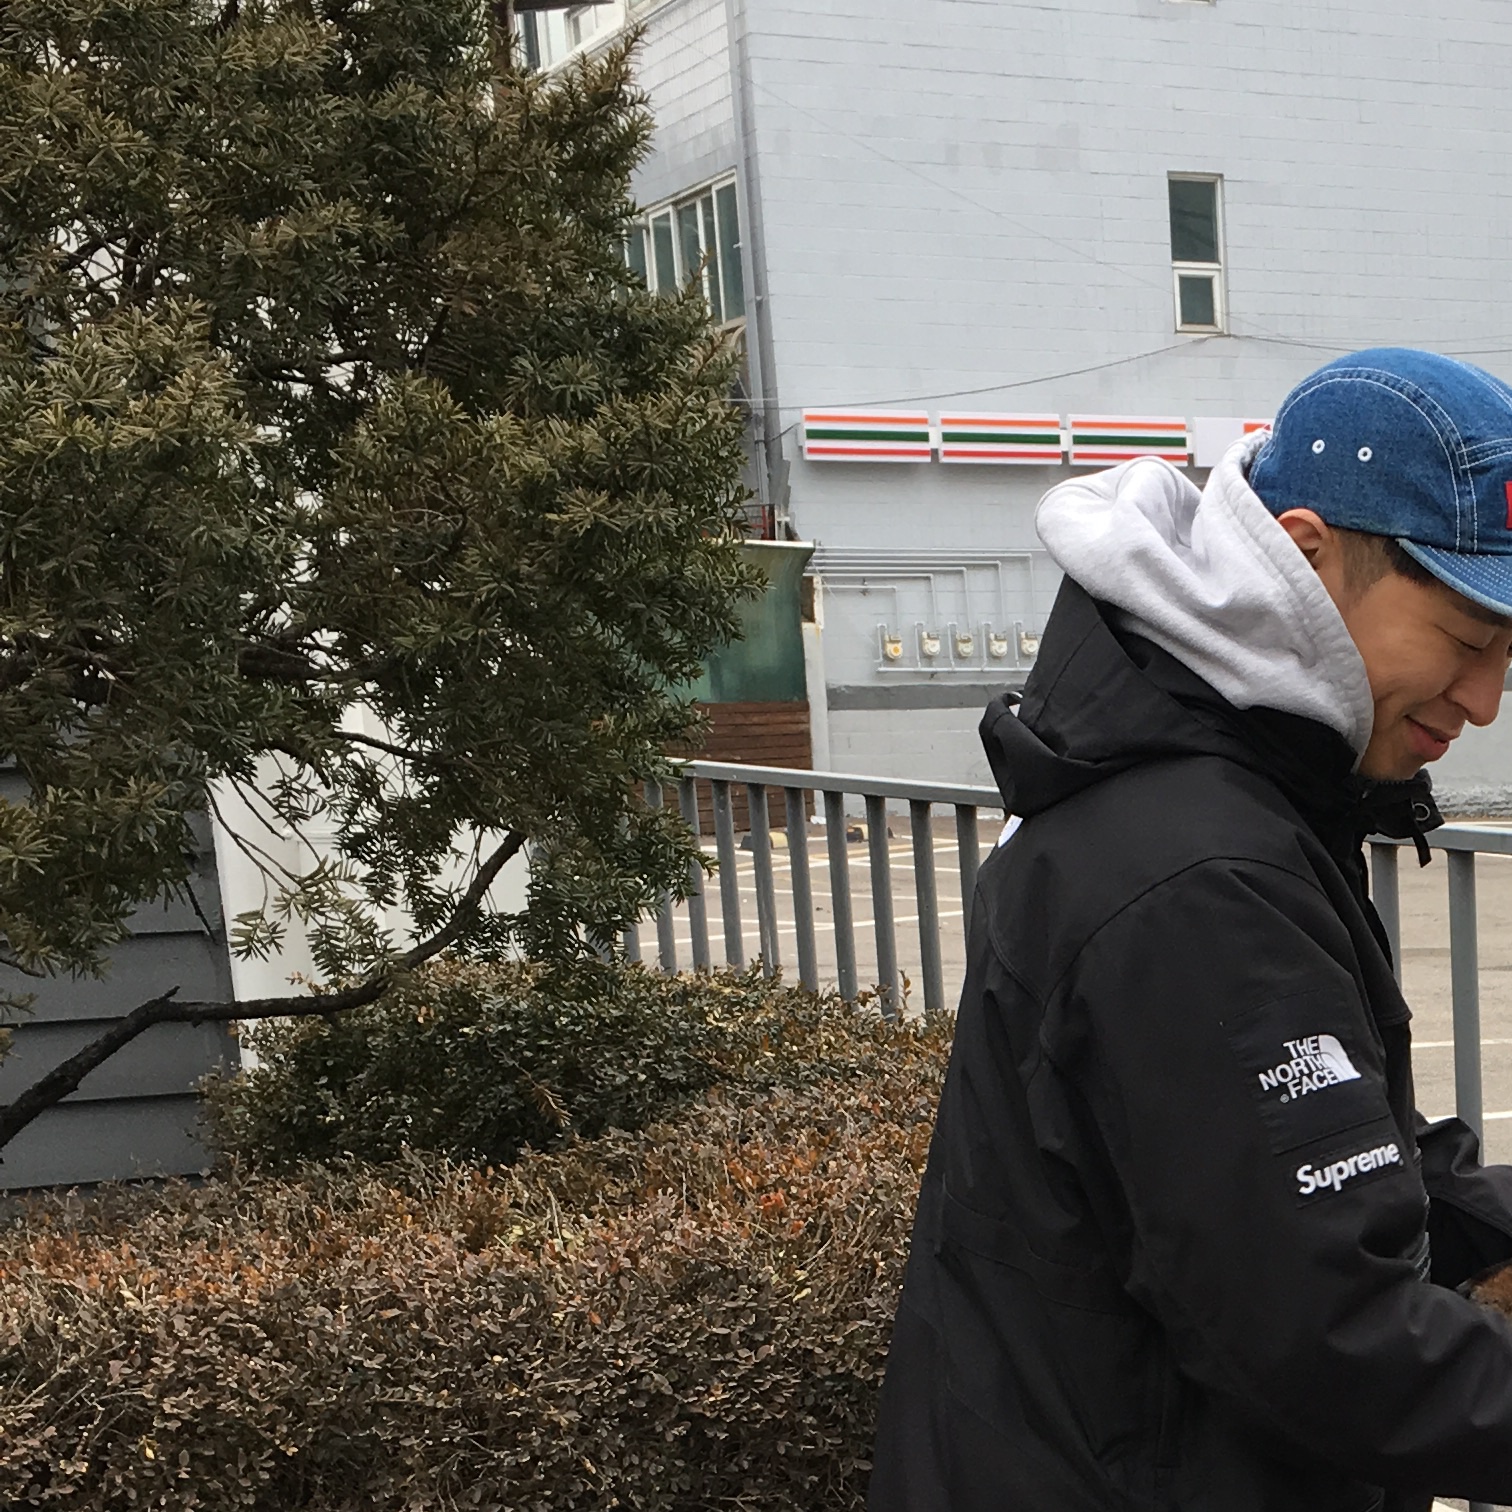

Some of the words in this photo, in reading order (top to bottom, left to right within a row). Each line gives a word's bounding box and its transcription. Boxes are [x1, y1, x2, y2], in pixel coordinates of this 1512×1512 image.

[1283, 1035, 1320, 1059] THE
[1258, 1053, 1326, 1091] NORTH
[1287, 1067, 1339, 1100] FACE
[1296, 1143, 1401, 1195] Supreme
